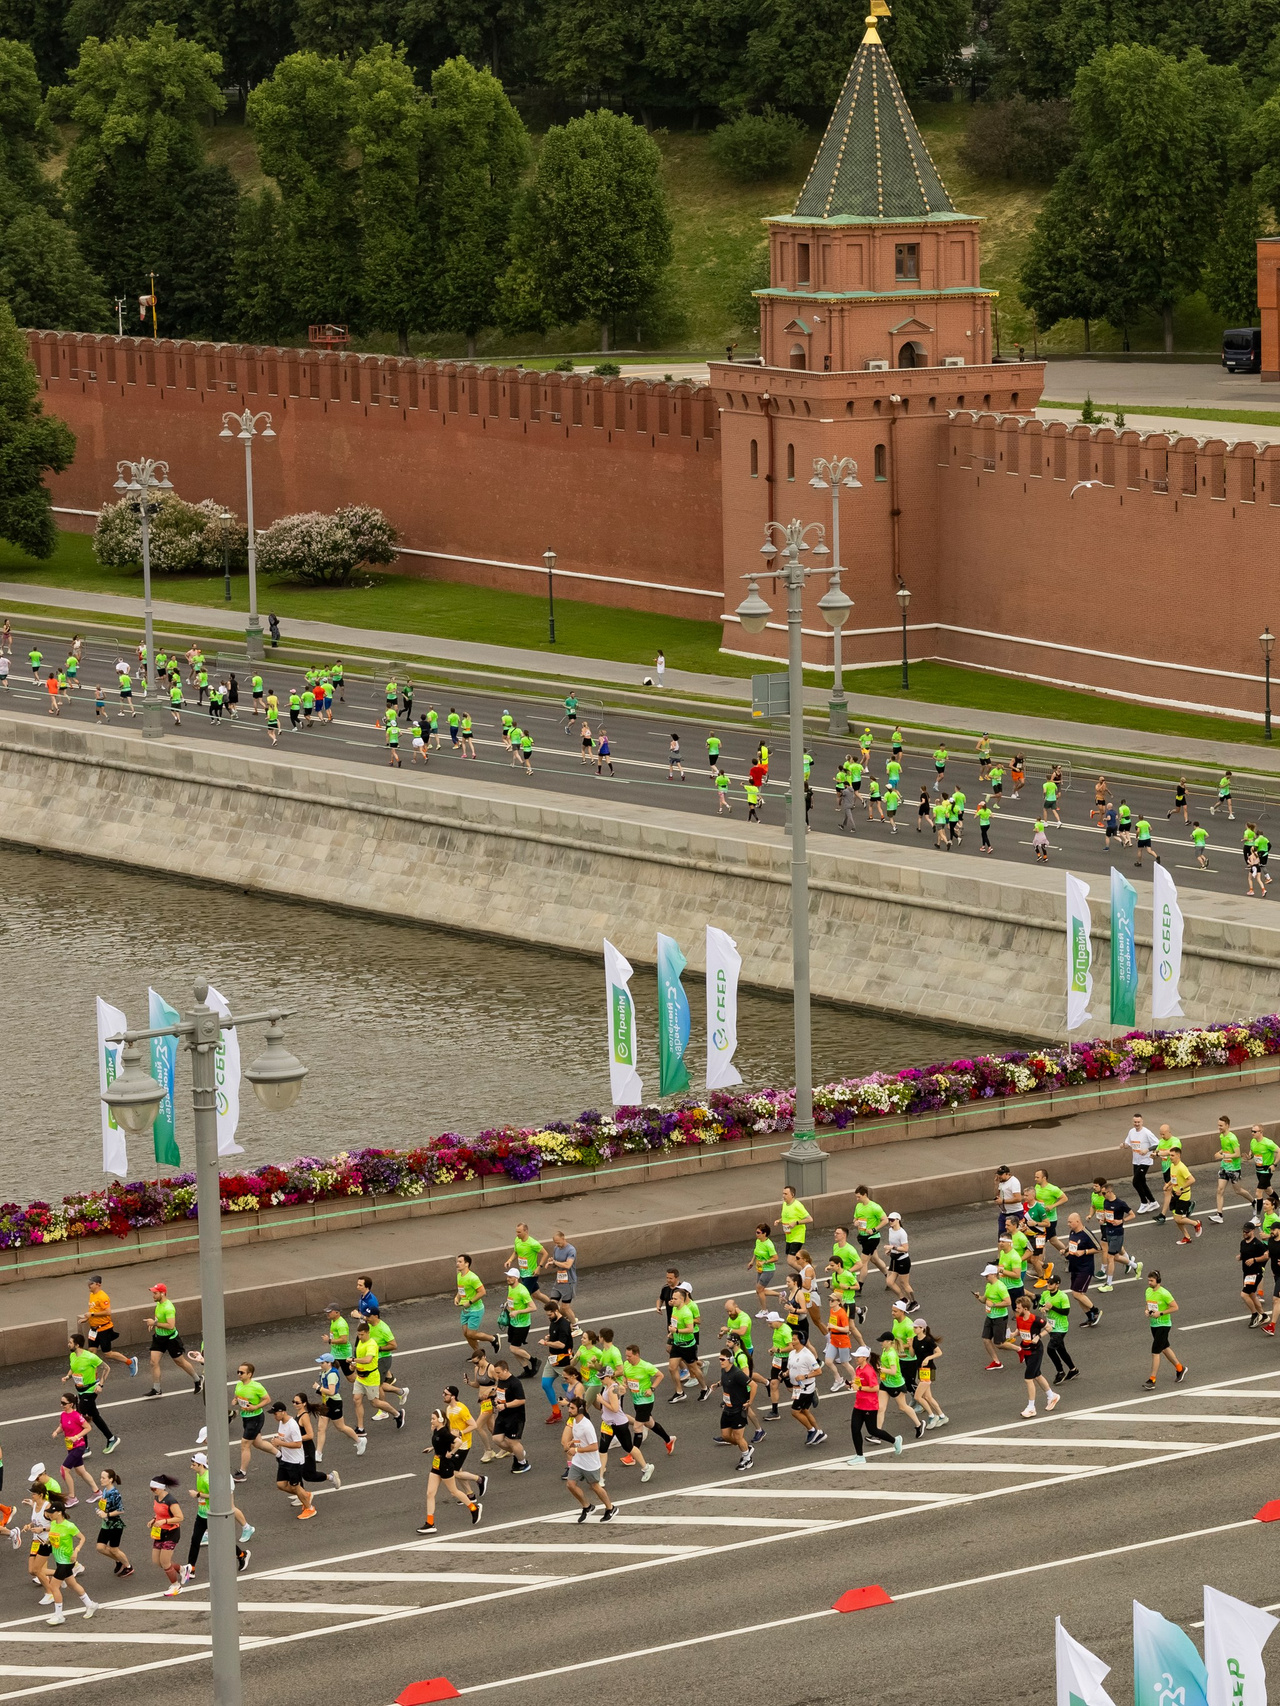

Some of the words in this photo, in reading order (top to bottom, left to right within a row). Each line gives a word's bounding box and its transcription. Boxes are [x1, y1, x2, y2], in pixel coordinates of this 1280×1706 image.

[1076, 926, 1086, 969] Прайм
[1162, 903, 1172, 954] СБЕР
[617, 995, 628, 1040] Прайм
